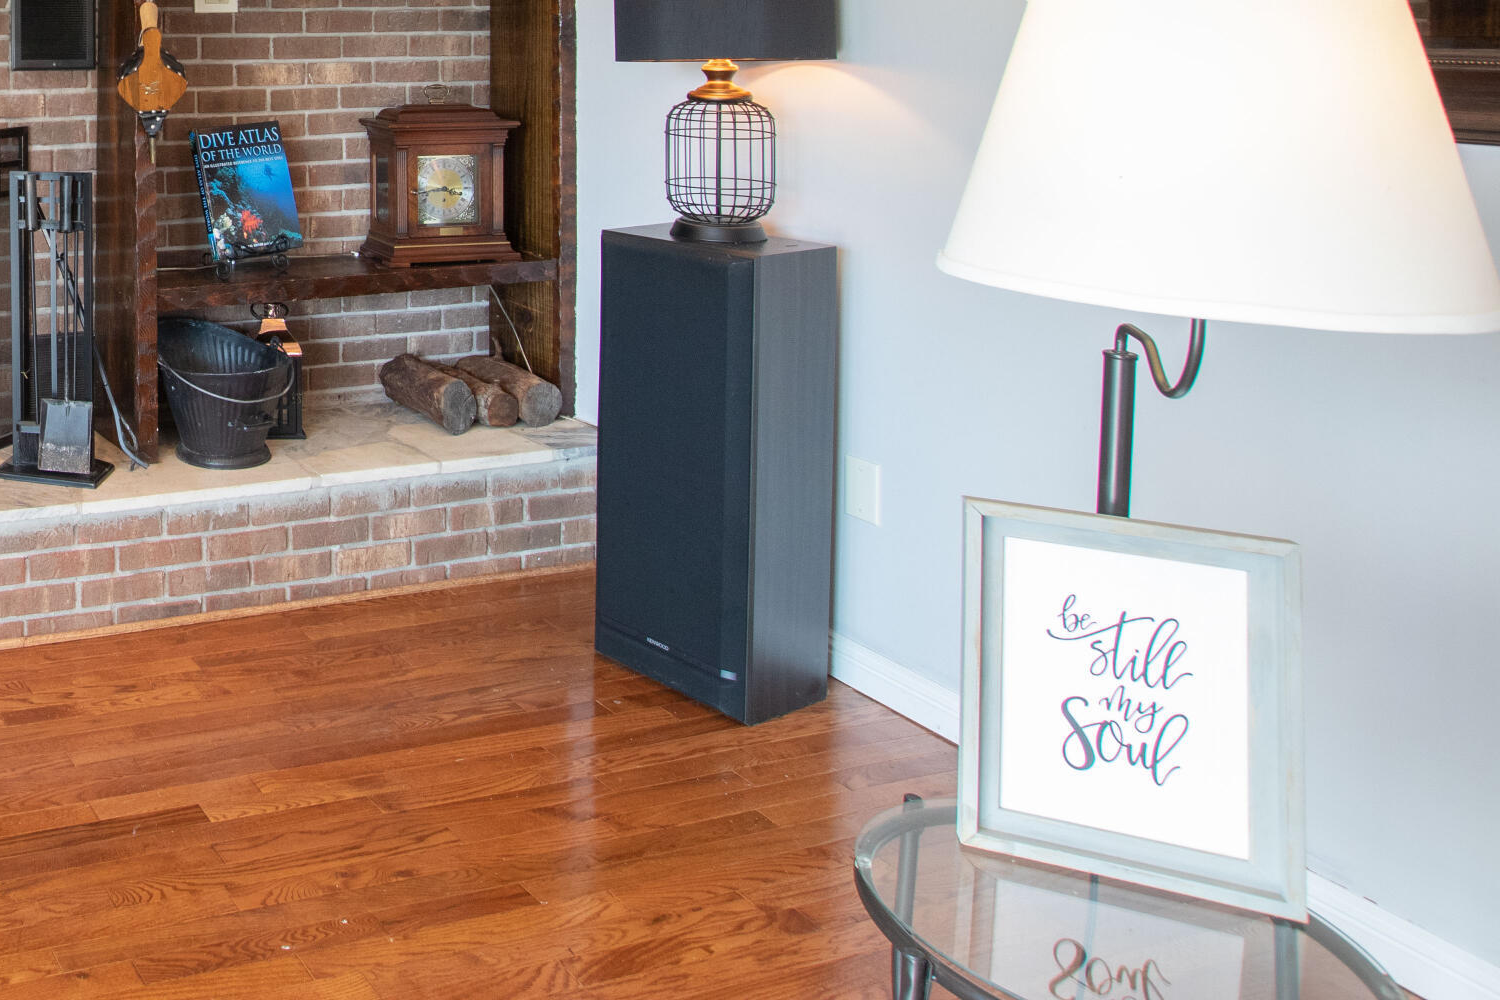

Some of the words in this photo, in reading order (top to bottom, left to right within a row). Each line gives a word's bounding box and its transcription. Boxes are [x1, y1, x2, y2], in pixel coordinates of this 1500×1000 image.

[198, 131, 236, 149] DIVE
[238, 126, 280, 145] ATLAS
[201, 150, 216, 163] OF
[217, 147, 240, 161] THE
[240, 143, 282, 157] WORLD
[1057, 594, 1097, 632] be
[1052, 611, 1194, 690] still
[1099, 685, 1164, 734] my
[1060, 696, 1190, 786] Soul
